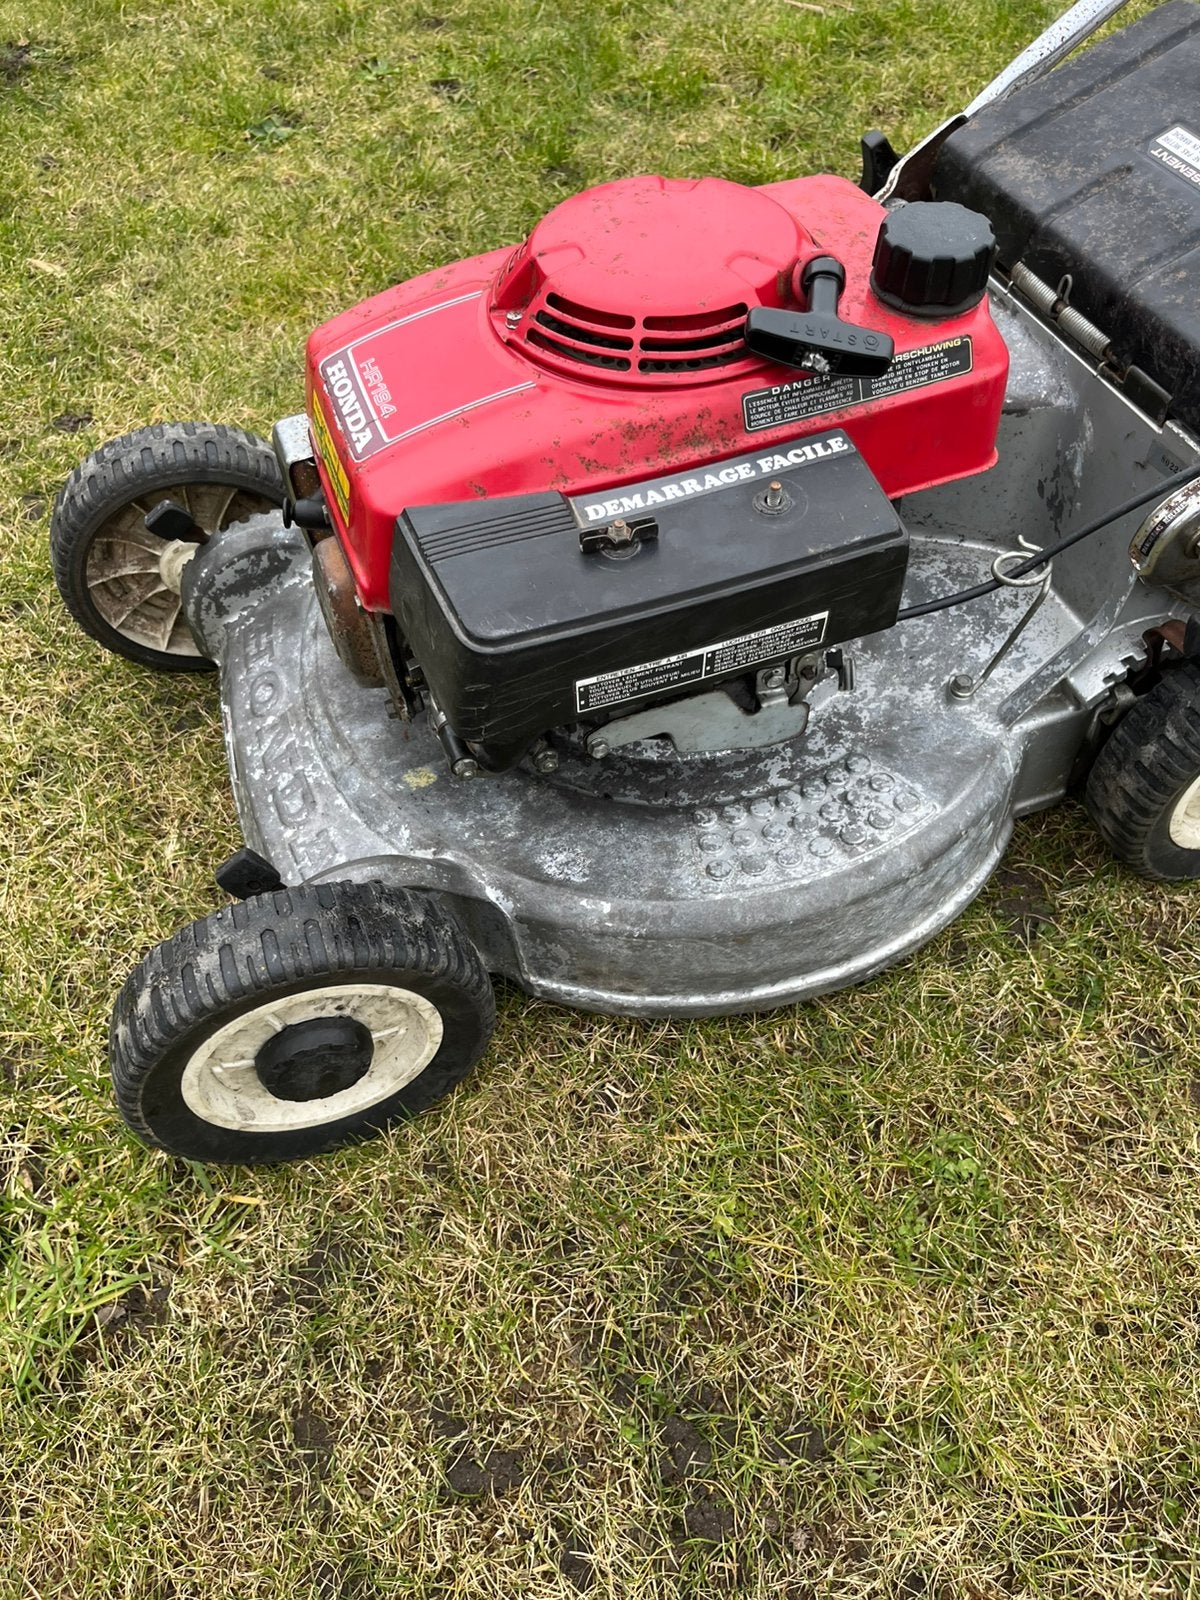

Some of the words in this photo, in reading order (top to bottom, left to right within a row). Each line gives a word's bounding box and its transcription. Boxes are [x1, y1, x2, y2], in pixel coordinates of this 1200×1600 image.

[1151, 148, 1200, 185] SEMENT
[791, 322, 858, 345] START
[359, 357, 398, 419] HR194
[771, 374, 830, 394] DANGER
[871, 380, 885, 388] OPEN
[888, 376, 902, 384] VUUR
[914, 369, 928, 377] STOP
[940, 360, 959, 369] MOTOR
[872, 384, 897, 395] VOORDAT
[905, 376, 927, 386] BENZINE
[326, 359, 373, 455] HONDA
[750, 411, 770, 420] SOURCE
[783, 402, 807, 411] CHALEUR
[819, 392, 843, 402] FLAMMES
[750, 416, 772, 426] MOMENT
[585, 463, 755, 520] DEMARRAGE
[757, 437, 847, 472] FACILE
[588, 690, 619, 702] NETTOYER
